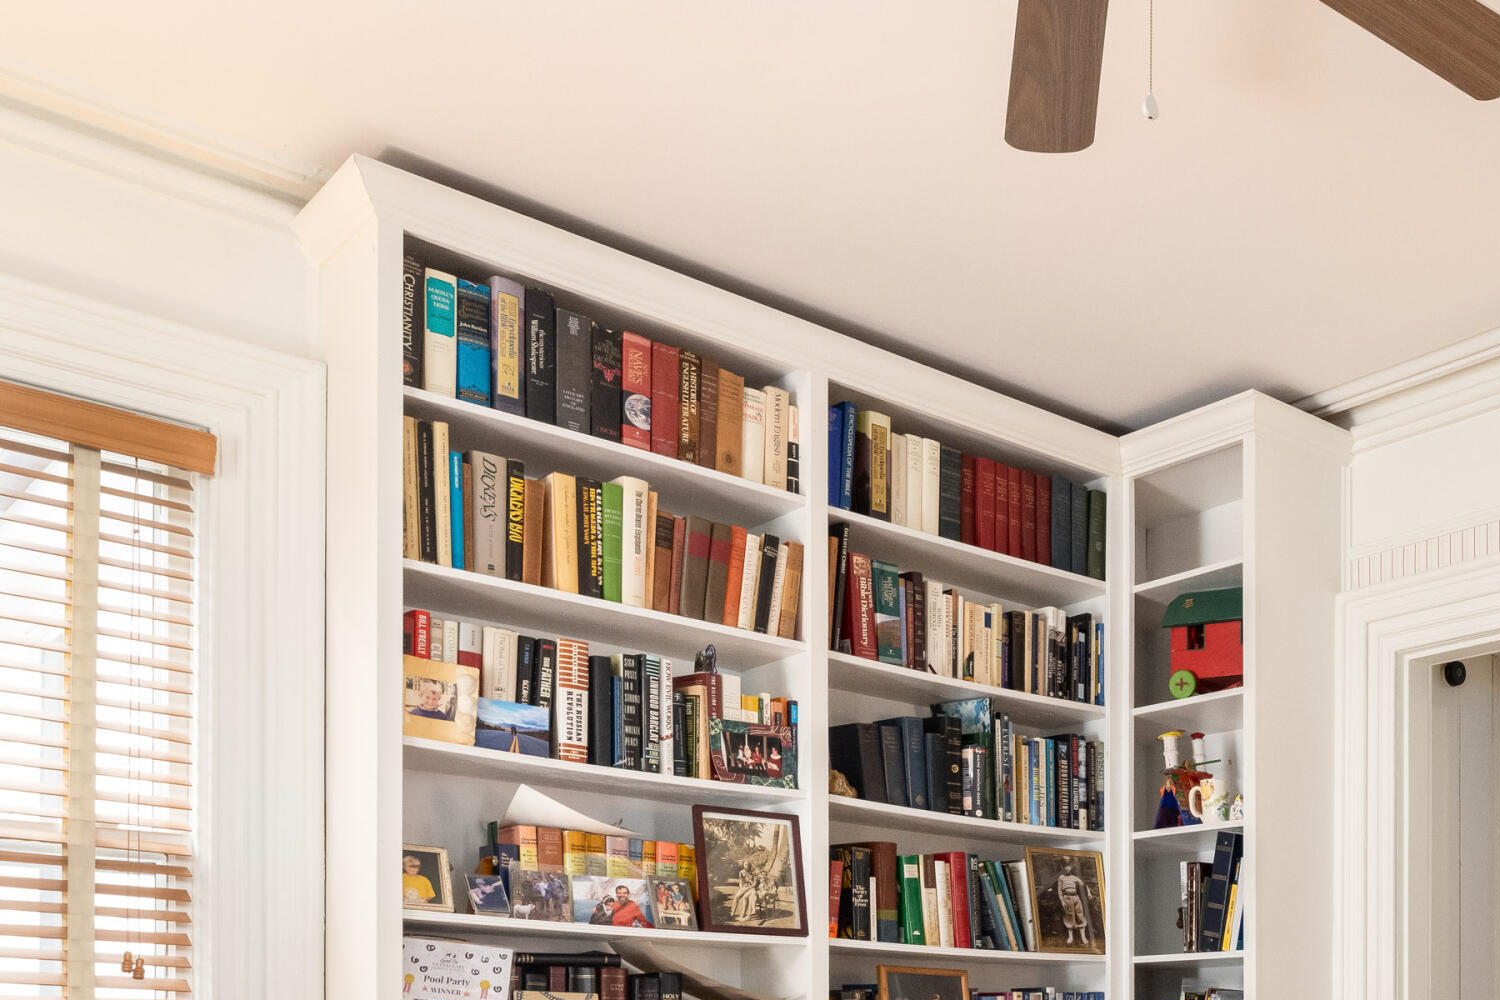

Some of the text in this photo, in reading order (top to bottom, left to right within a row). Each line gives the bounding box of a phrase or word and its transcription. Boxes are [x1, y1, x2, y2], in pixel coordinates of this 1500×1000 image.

[403, 273, 416, 352] CHRISTIANITY
[681, 362, 690, 445] ENGLISH LITERATURE
[689, 372, 697, 404] HISTORY
[690, 404, 697, 416] OF
[417, 614, 427, 656] BILL O'REILLY
[860, 577, 869, 648] Bible Dictionary
[566, 690, 574, 742] REVOLUTION
[575, 692, 583, 742] THE RUSSIAN
[649, 674, 660, 748] LINWOOD BARCLAY
[423, 974, 471, 988] Pool Party
[429, 987, 462, 997] WINNER
